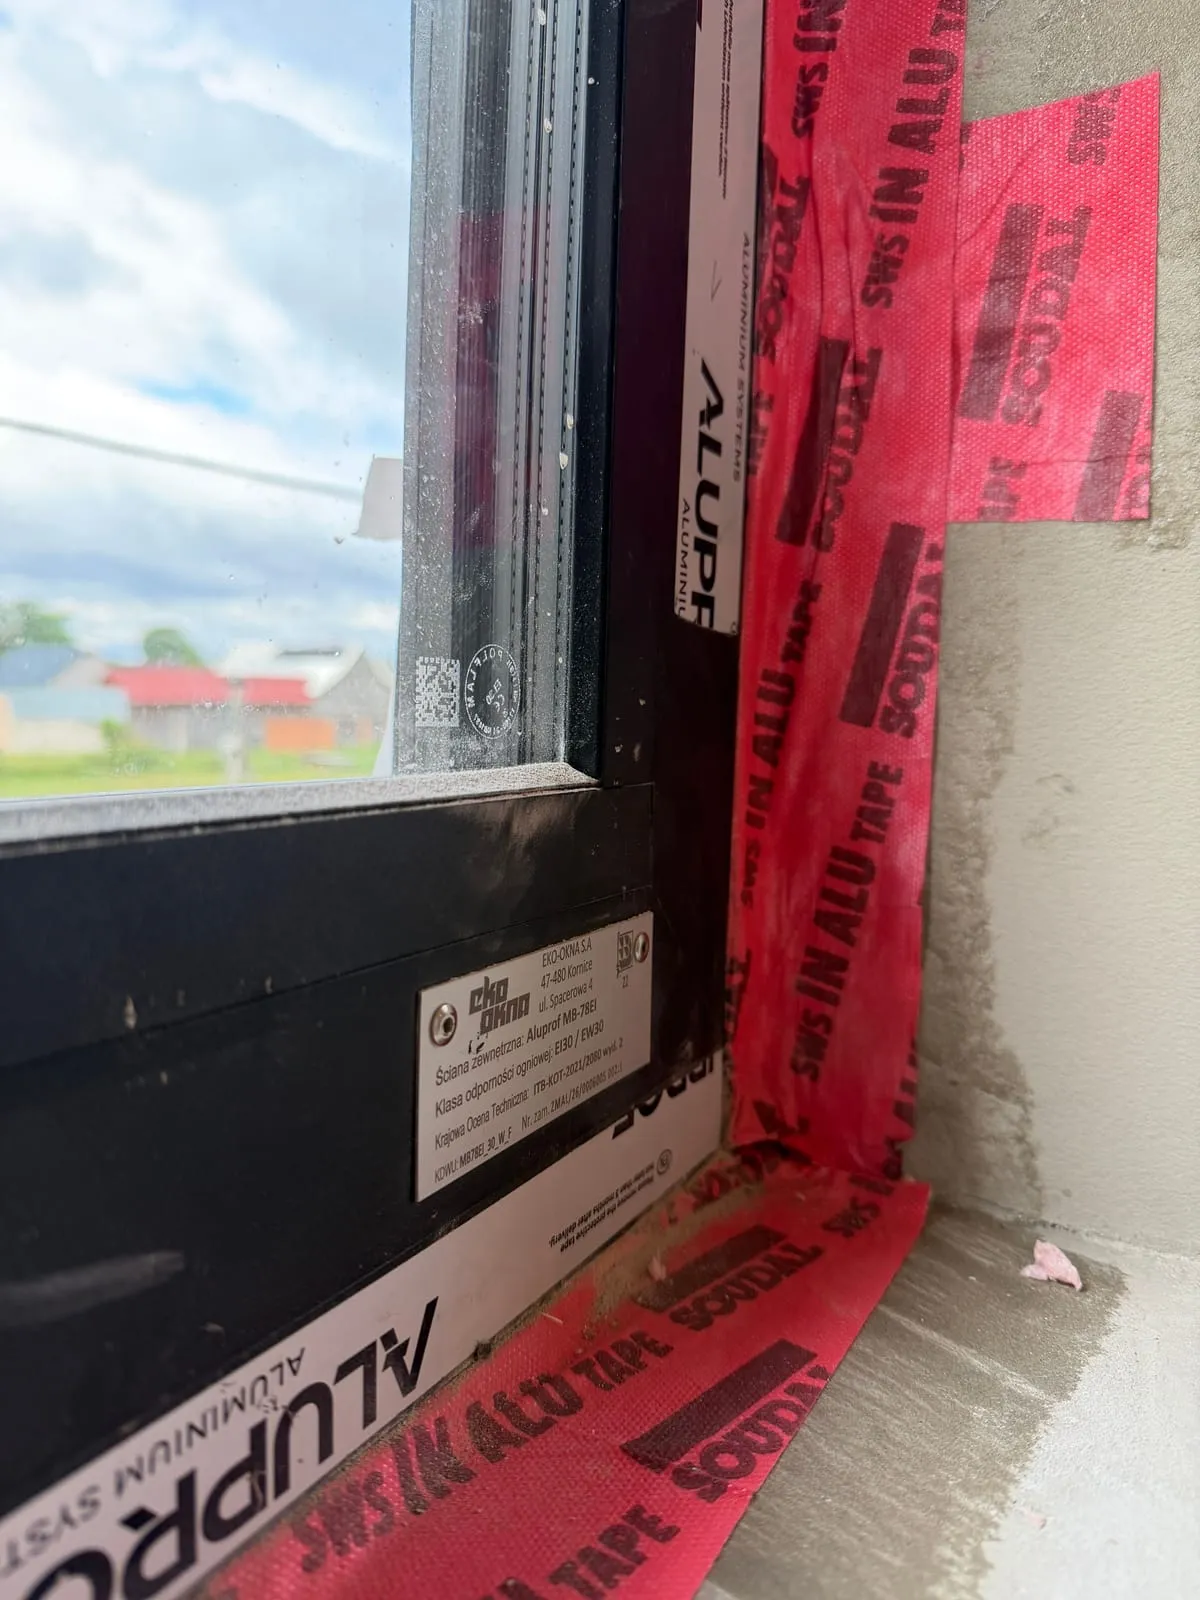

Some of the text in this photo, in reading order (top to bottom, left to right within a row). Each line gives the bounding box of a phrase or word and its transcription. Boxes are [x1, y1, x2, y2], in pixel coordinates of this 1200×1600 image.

[887, 48, 959, 154] ALU
[869, 167, 929, 224] IN
[861, 232, 910, 309] SWS
[732, 231, 750, 482] ALUMINIUM SYSTEMS
[1001, 205, 1093, 427] SOUDAL
[811, 346, 883, 553] SOUDAL
[752, 669, 797, 769] ALU
[745, 774, 774, 830] IN
[542, 940, 580, 968] EKO-OKNA
[791, 760, 903, 1083] SWS IN ALU TAPE
[469, 975, 509, 1015] eko
[480, 992, 531, 1036] okna
[539, 978, 593, 1013] ul. Spacerowa 4
[540, 959, 593, 990] 47-480 Kornice
[435, 1060, 470, 1086] Ściana
[526, 1013, 561, 1044] Aluprof
[562, 998, 597, 1026] MB-78EI
[435, 1018, 604, 1118] Klasa odporności ogniowej: EI30 / EW30
[434, 1158, 458, 1184] KDWU:
[522, 1115, 533, 1132] Nr.
[435, 1127, 465, 1150] Krajowa
[466, 1111, 489, 1132] Ocena
[671, 1241, 823, 1331] SOUDAL
[573, 1328, 674, 1393] TAPE
[0, 1347, 307, 1577] ALUMINIUM SYST
[549, 1504, 681, 1600] TAPE
